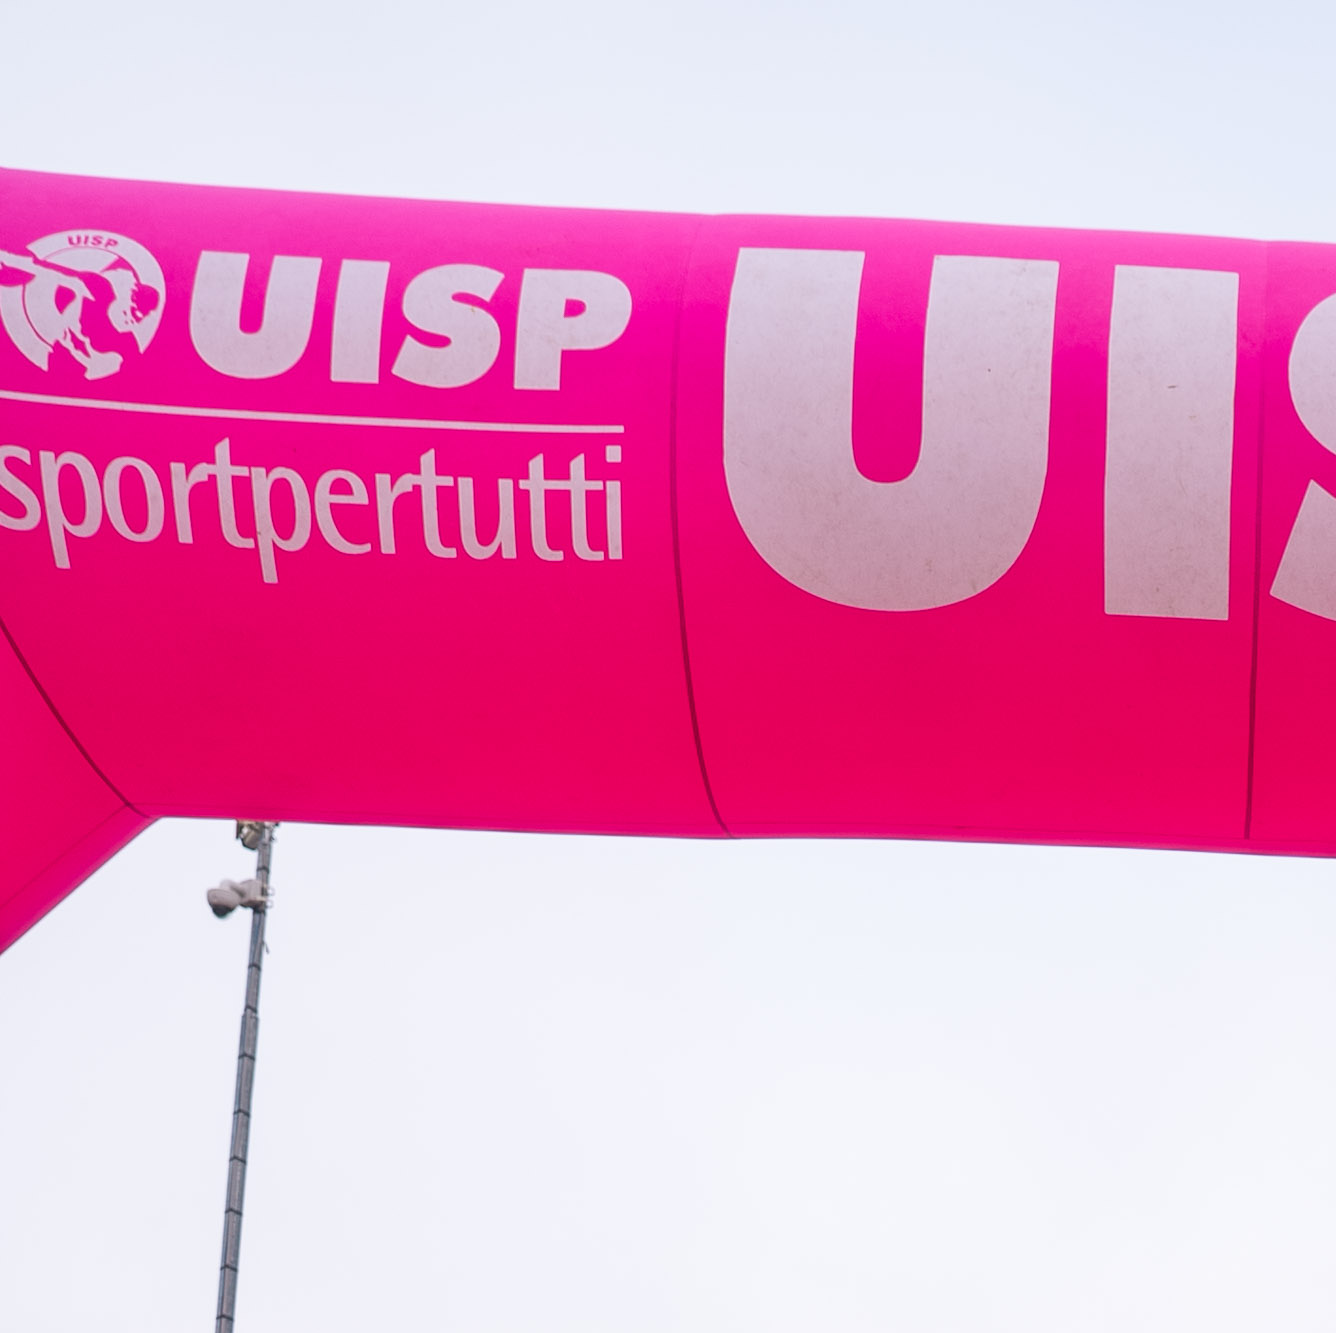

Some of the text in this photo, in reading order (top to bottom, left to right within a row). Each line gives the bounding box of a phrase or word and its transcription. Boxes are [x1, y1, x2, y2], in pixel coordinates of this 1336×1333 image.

[67, 234, 118, 249] UISP
[190, 250, 633, 391] UISP
[0, 437, 624, 584] sportpertutti
